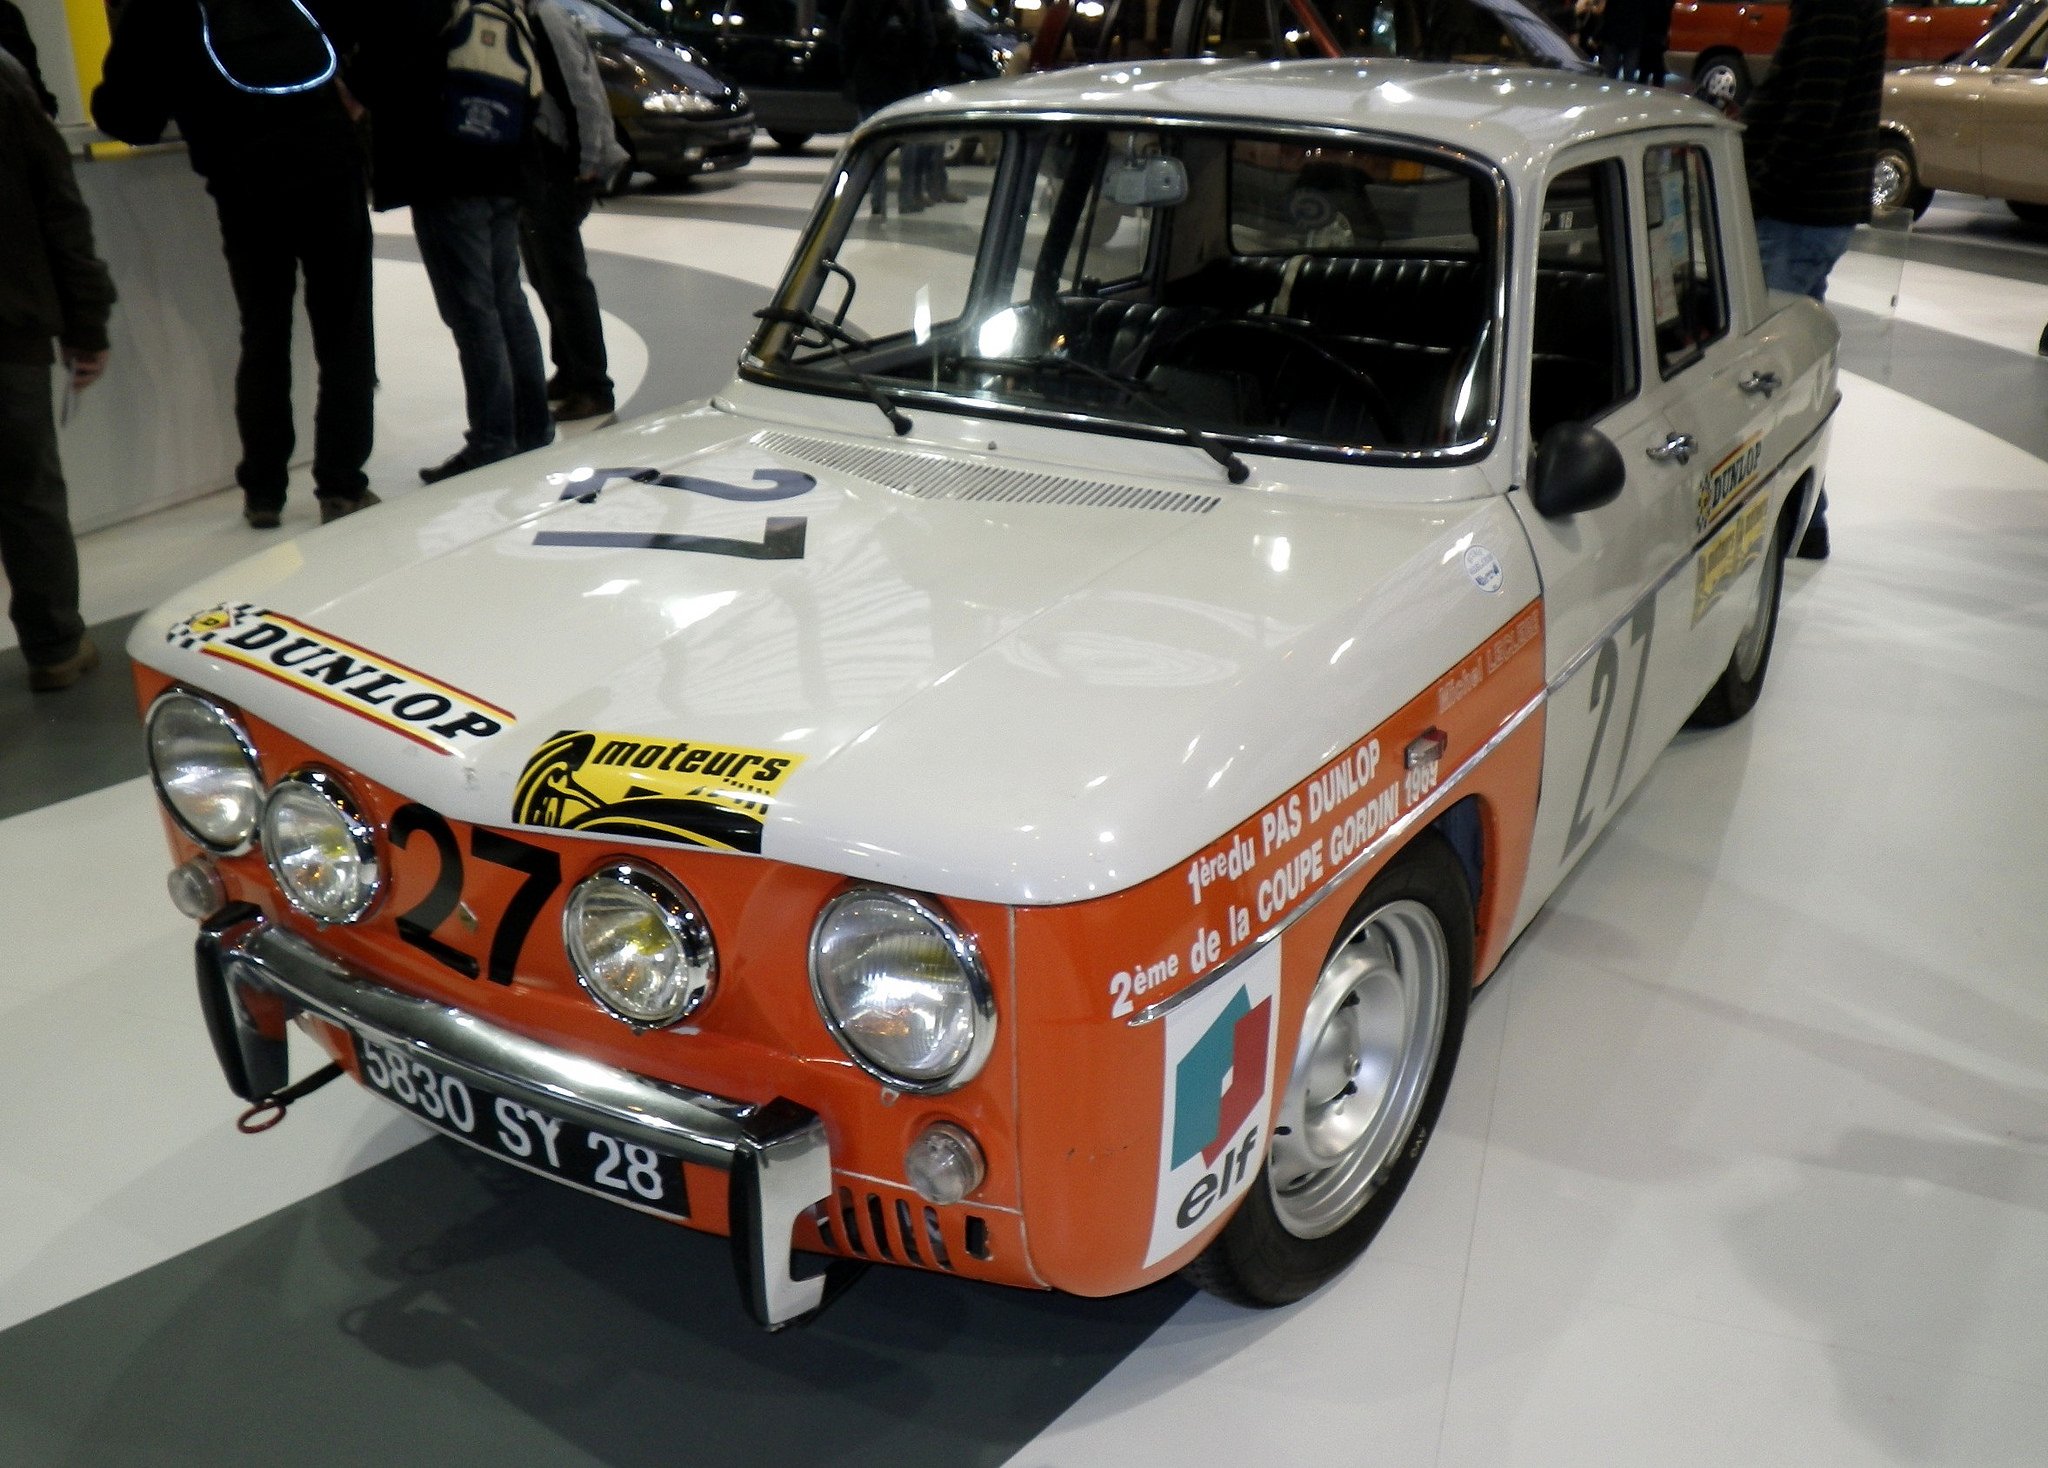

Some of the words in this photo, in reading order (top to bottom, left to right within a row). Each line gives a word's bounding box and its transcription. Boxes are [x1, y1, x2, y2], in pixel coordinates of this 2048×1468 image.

[1712, 441, 1761, 508] DUNLOP
[225, 622, 501, 739] DUNLOP
[1560, 589, 1657, 866] 27
[592, 740, 791, 782] moteurs
[1262, 794, 1302, 856] PAS
[1308, 738, 1380, 824] DUNLOP
[388, 803, 562, 986] 27
[1110, 953, 1179, 1019] 2ème
[1190, 927, 1221, 974] de
[1229, 905, 1251, 946] la
[1256, 838, 1324, 923] COUPE
[1329, 780, 1400, 866] GORDINI
[362, 1038, 475, 1133] 5830
[494, 1097, 560, 1169] SY
[587, 1132, 664, 1200] 28
[1176, 1124, 1259, 1230] elf
